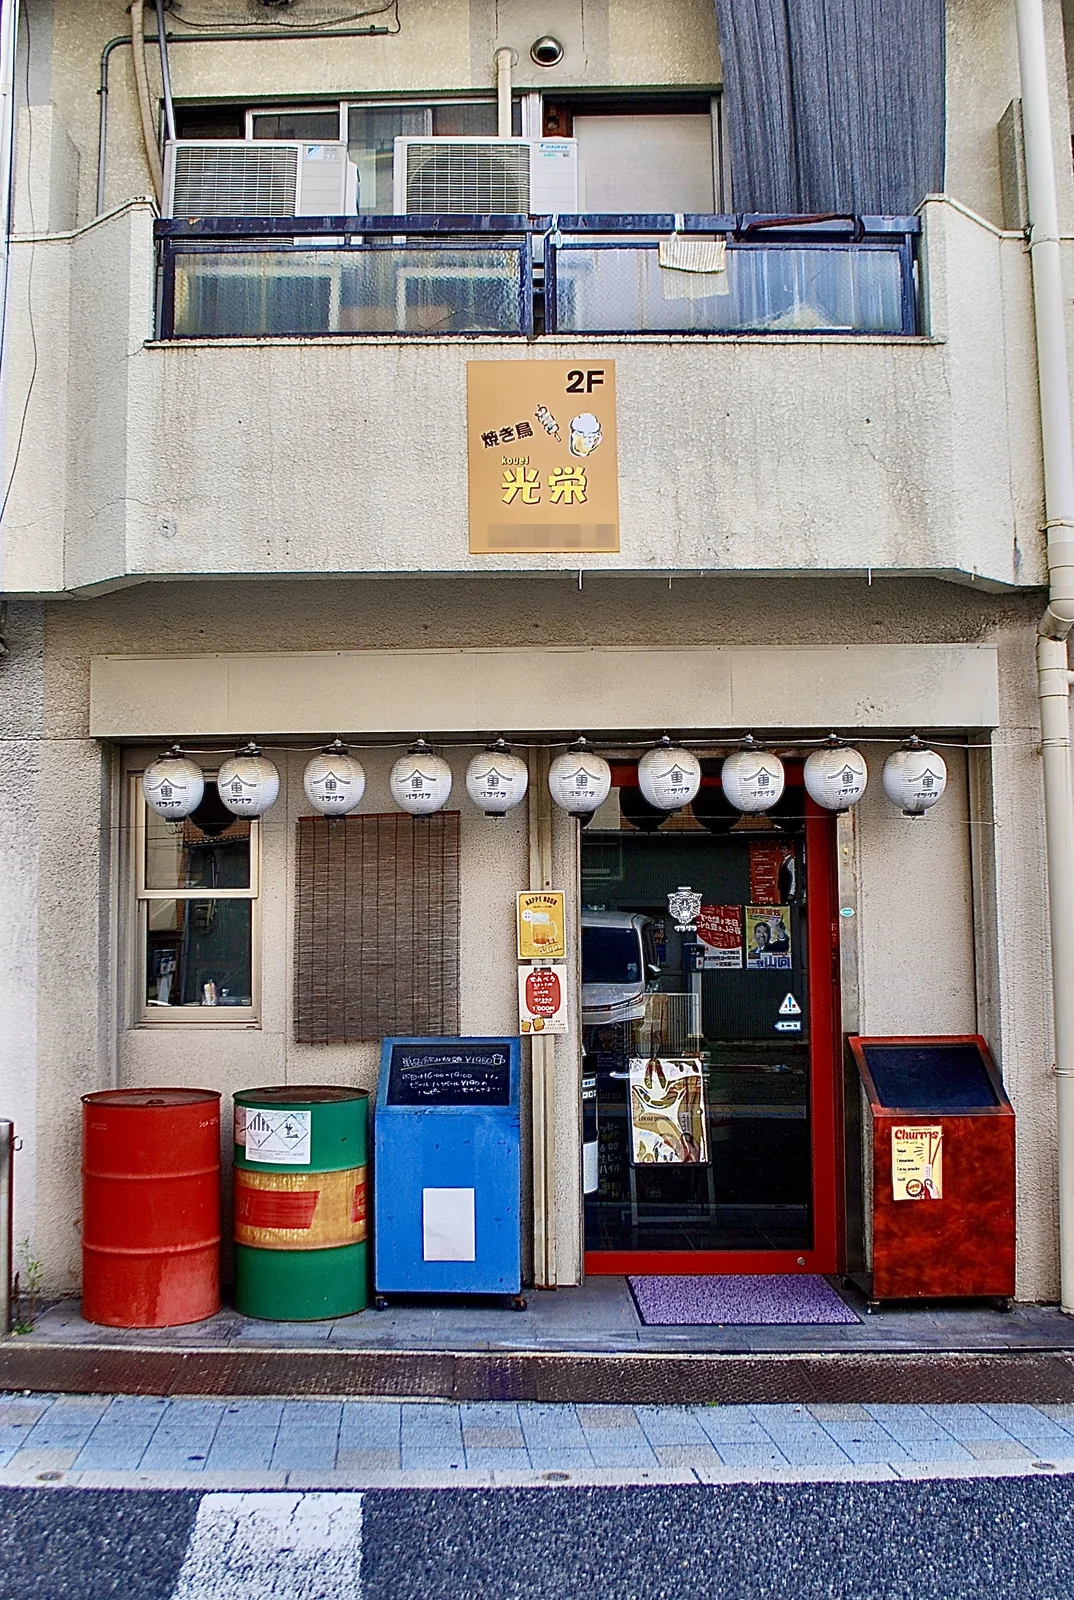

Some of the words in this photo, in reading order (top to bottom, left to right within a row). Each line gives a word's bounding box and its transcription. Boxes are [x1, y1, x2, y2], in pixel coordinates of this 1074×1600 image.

[566, 370, 604, 393] 2F
[481, 421, 534, 449] 焼き鳥
[501, 456, 529, 465] kouei
[502, 466, 588, 504] 光栄
[525, 896, 542, 906] HAPPY
[543, 896, 558, 906] HOUR
